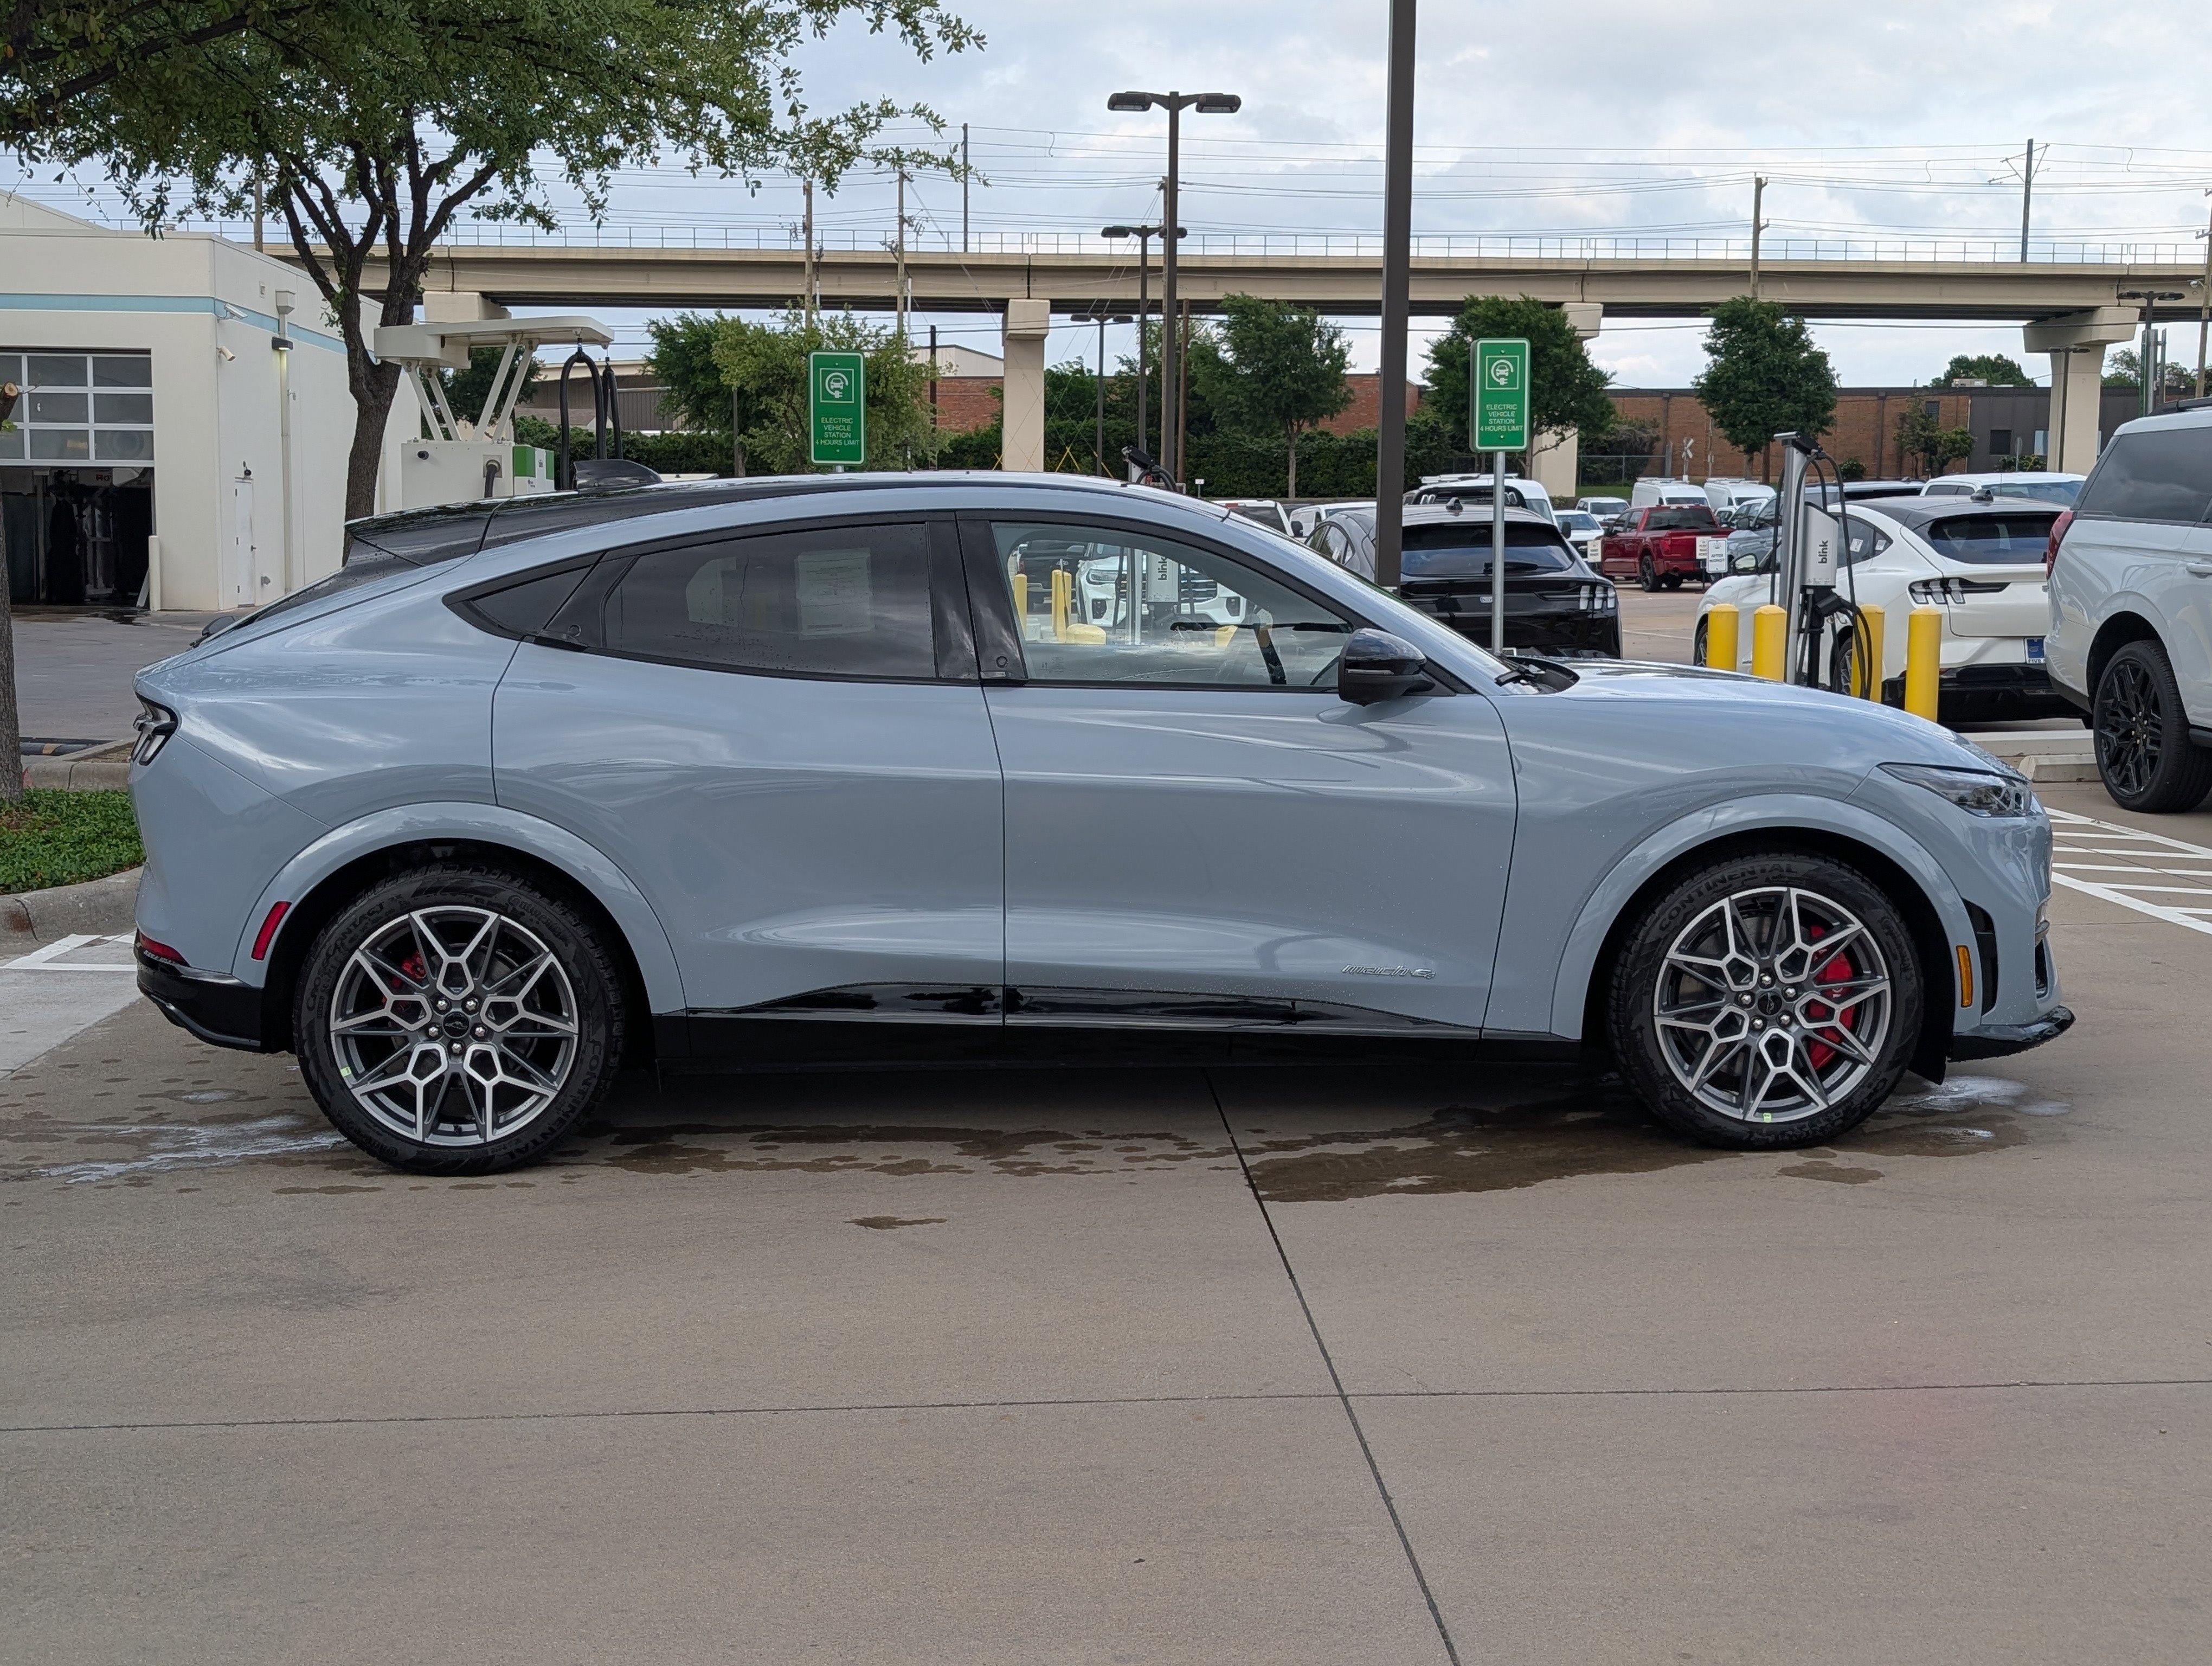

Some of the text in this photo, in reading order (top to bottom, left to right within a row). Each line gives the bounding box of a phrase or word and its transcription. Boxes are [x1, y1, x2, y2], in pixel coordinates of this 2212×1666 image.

[1818, 540, 1829, 564] blink
[1158, 556, 1167, 580] blink
[1659, 863, 1798, 932] CONTINENTAL
